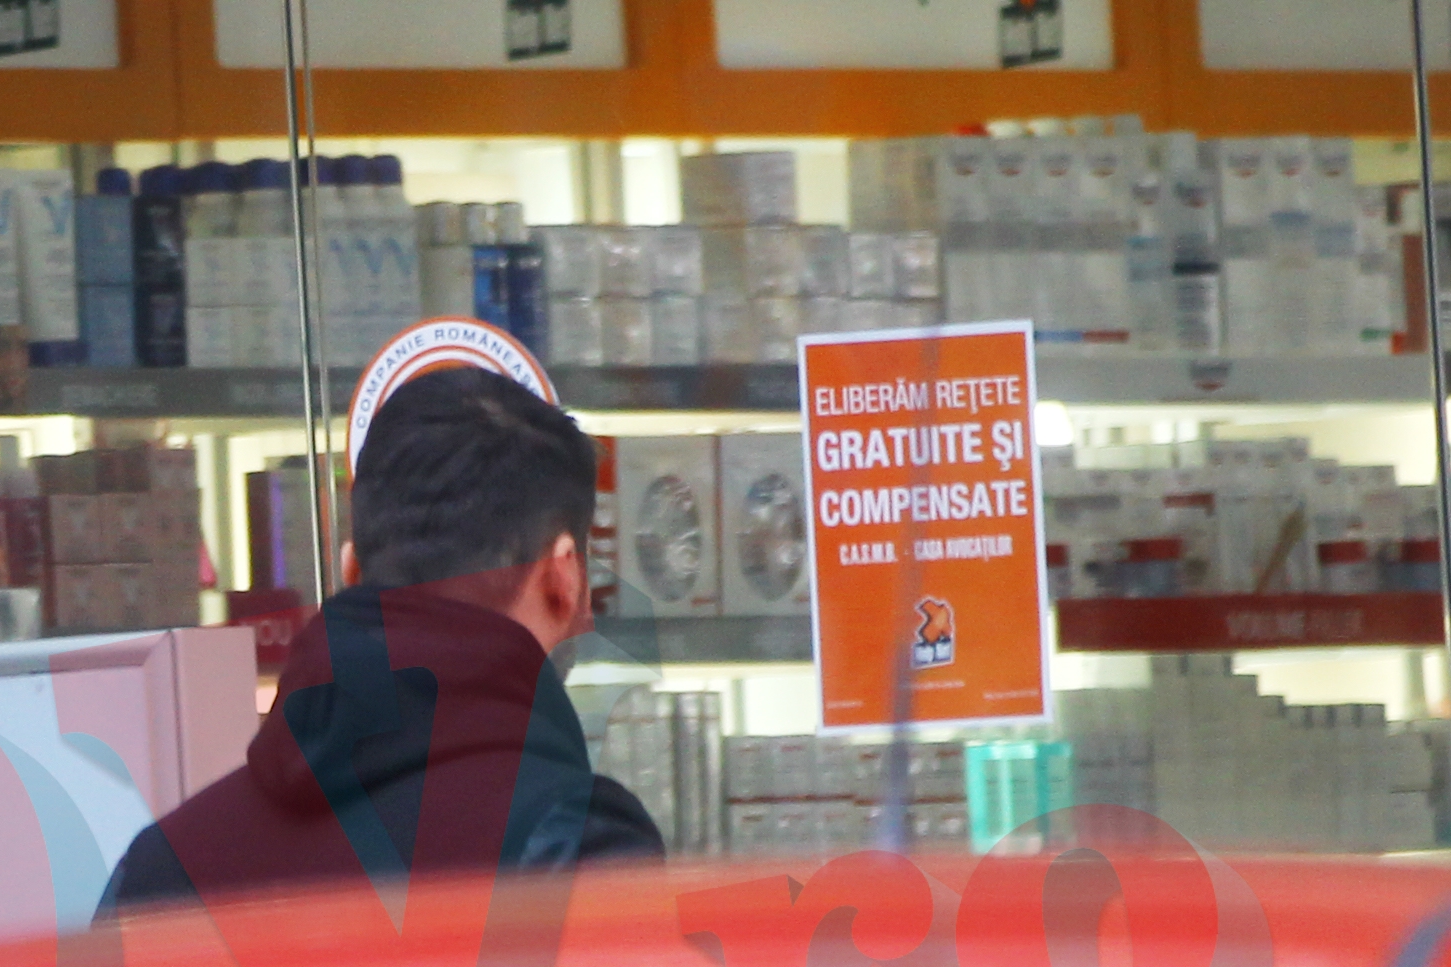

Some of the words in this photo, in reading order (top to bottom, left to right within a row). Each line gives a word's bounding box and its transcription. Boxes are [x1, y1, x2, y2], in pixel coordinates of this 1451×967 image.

[355, 335, 426, 430] COMPANIE
[814, 377, 930, 416] ELIBERĂM
[816, 422, 984, 472] GRATUITE
[819, 479, 1028, 528] COMPENSATE
